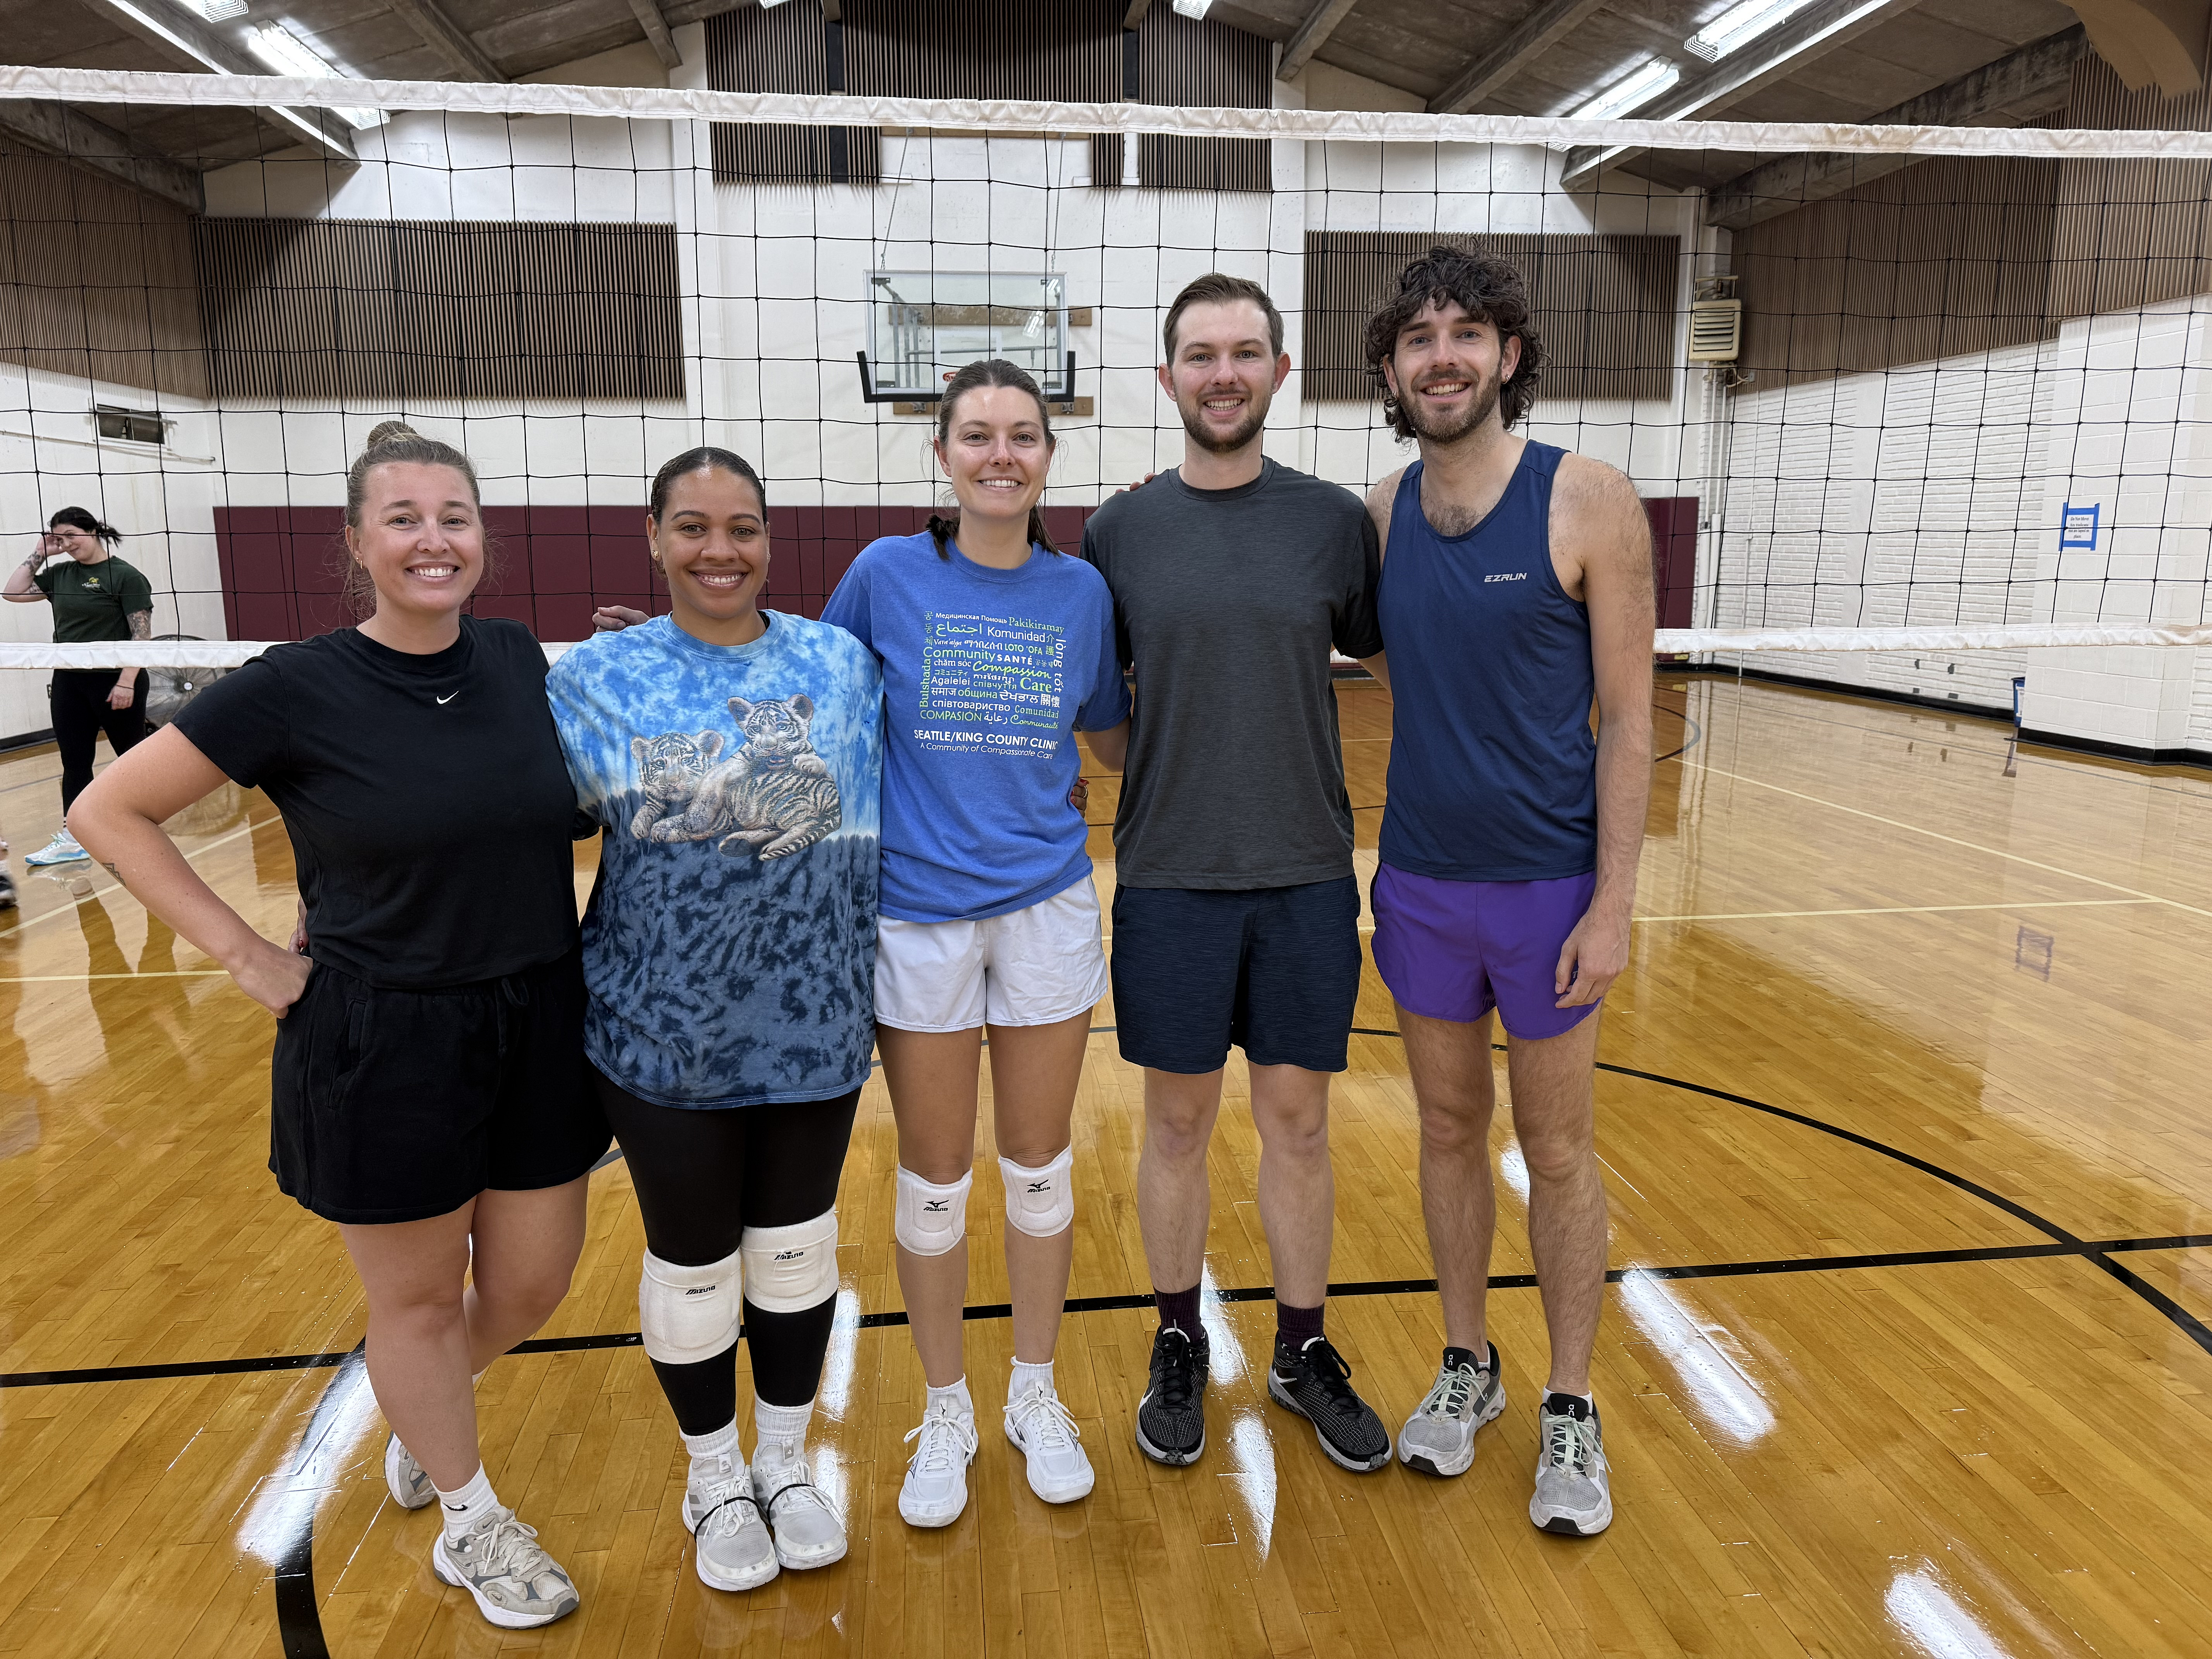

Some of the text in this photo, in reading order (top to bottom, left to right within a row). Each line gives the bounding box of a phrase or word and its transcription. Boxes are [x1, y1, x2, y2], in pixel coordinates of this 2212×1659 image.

[1484, 572, 1527, 582] EZRUN
[981, 615, 1007, 623] Помощь
[1008, 617, 1064, 635] Pakikiramay
[936, 621, 982, 636] اجتماع
[988, 626, 1045, 642] Komunidad
[923, 647, 996, 662] Community
[1005, 643, 1024, 652] LOTO
[997, 654, 1032, 665] SANTÉ
[973, 660, 1051, 679] Compassion
[919, 659, 931, 708] Bulshada
[931, 676, 970, 686] Agalelei
[973, 680, 1017, 690] співчуття
[1020, 677, 1052, 693] Care
[931, 687, 957, 696] समाज
[958, 688, 997, 699] община
[933, 699, 1010, 711] співтовариство
[1015, 705, 1059, 719] Comunidad
[920, 710, 982, 721] COMPASIÓN
[984, 711, 1008, 725] رعاية
[1010, 714, 1059, 729] Communauté
[914, 730, 983, 743] SEATTLE/KING
[986, 733, 1029, 746] COUNTY
[926, 743, 970, 753] Community
[981, 745, 1036, 756] Compassionate
[1037, 751, 1053, 759] Care
